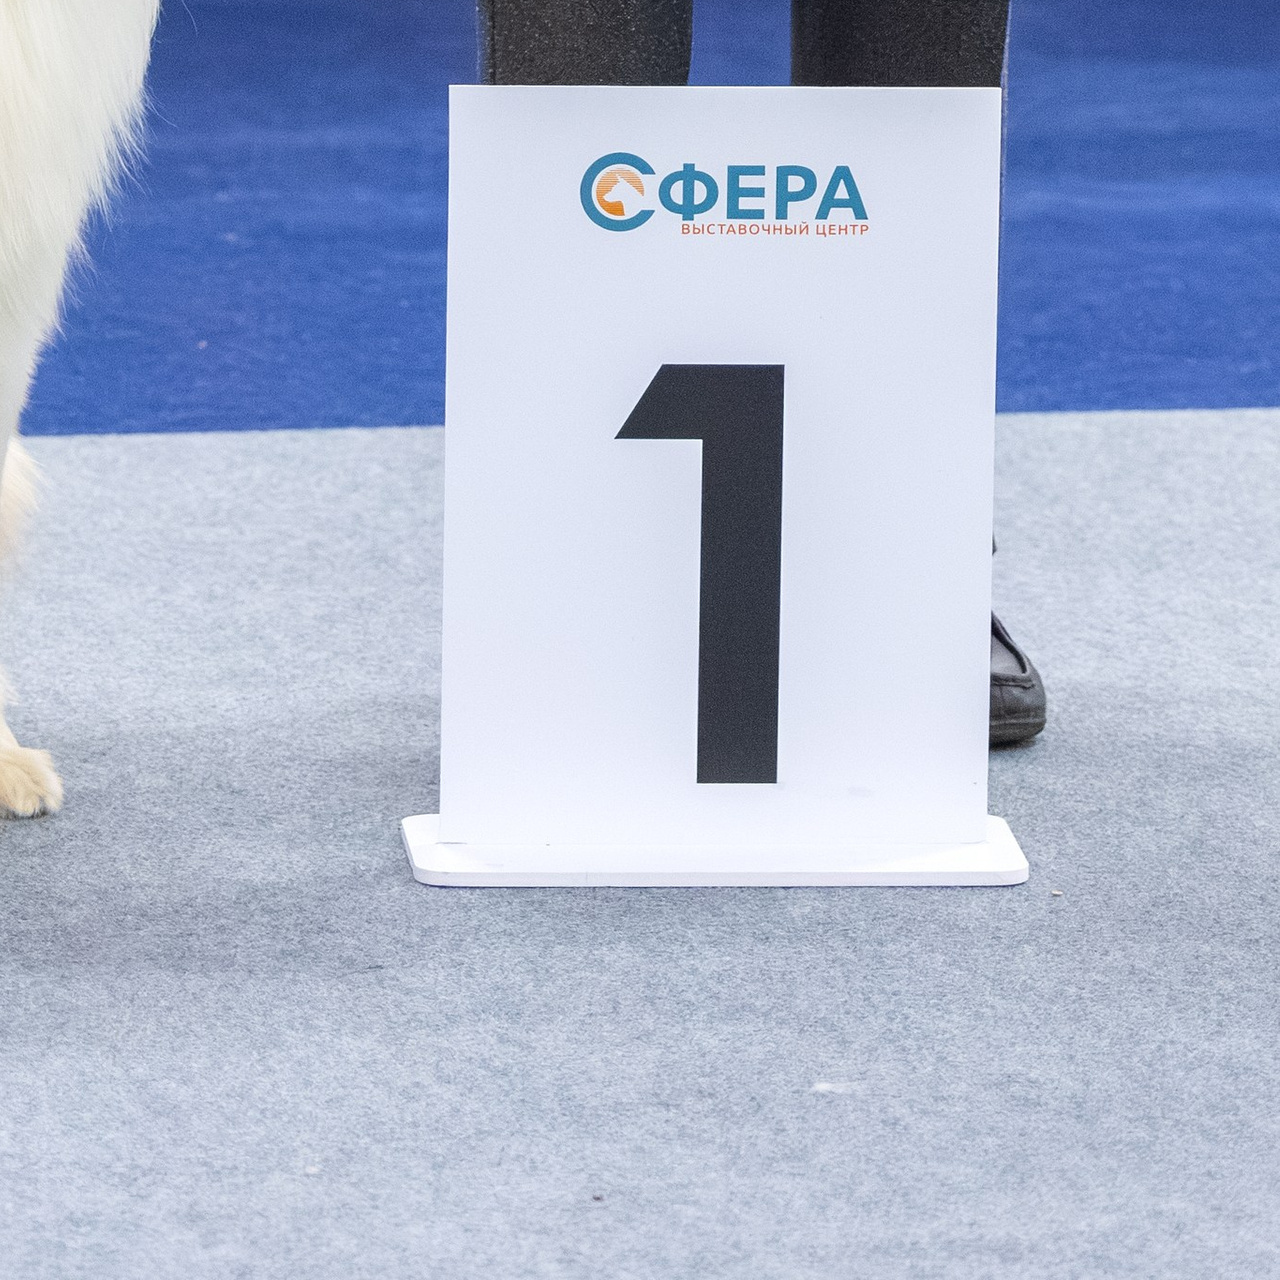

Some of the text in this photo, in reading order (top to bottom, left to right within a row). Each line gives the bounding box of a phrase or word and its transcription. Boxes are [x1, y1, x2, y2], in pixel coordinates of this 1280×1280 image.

[579, 151, 870, 232] СФЕРА
[680, 221, 870, 238] ВЫСТАВОЧНЫЙ ЦЕНТР
[614, 363, 785, 784] 1
